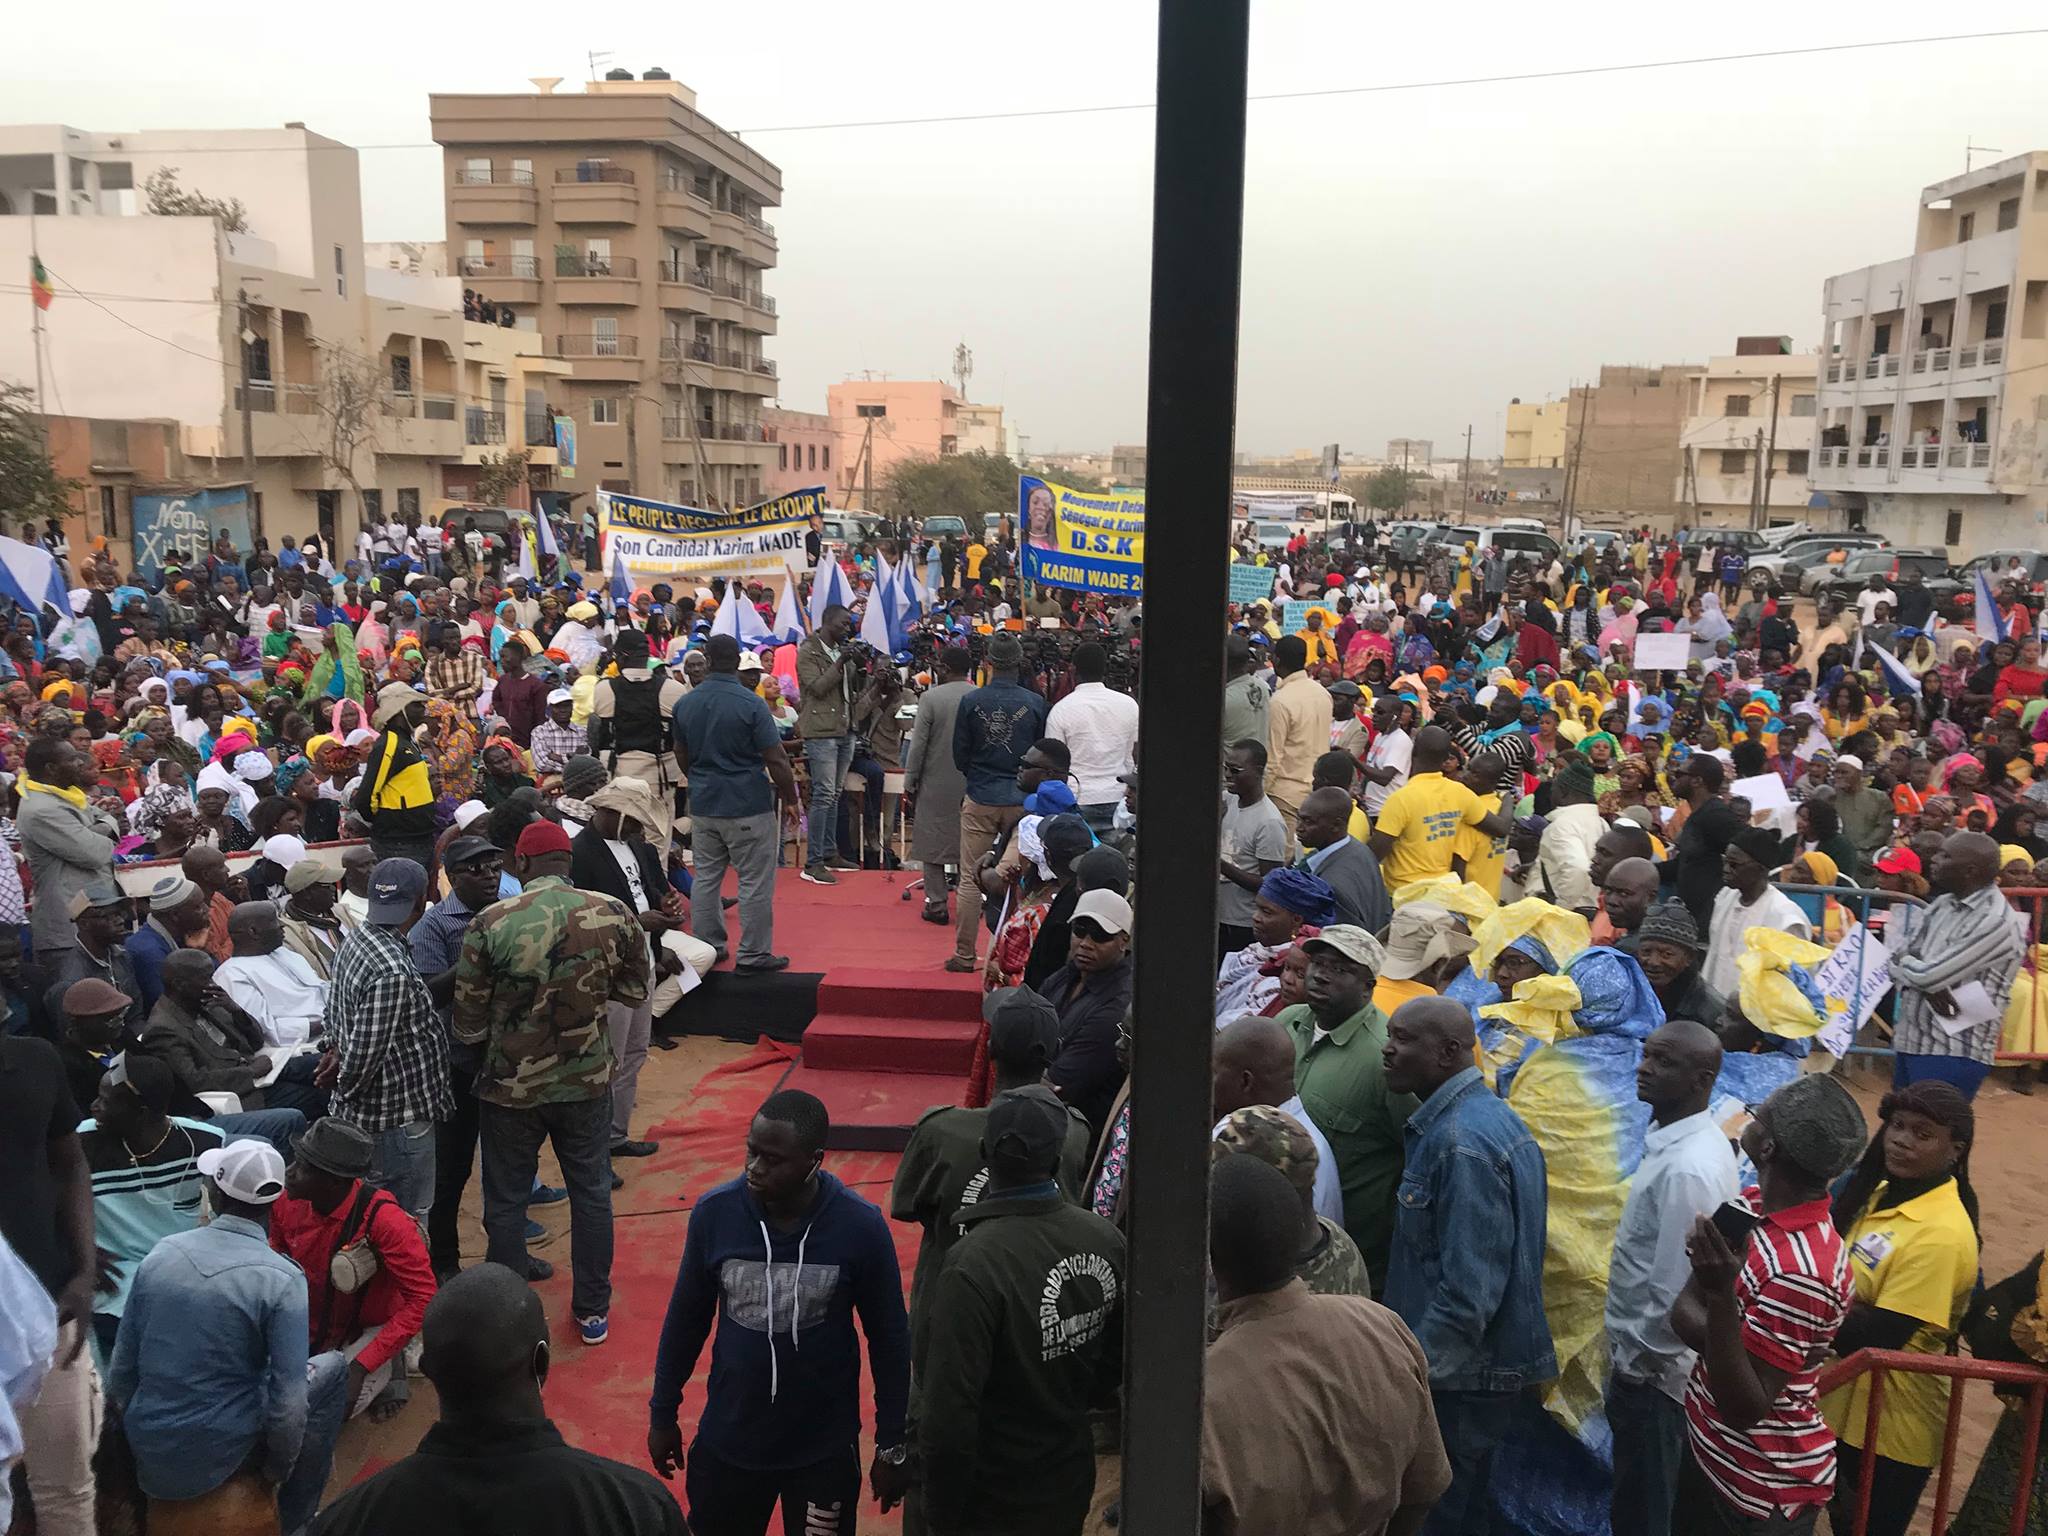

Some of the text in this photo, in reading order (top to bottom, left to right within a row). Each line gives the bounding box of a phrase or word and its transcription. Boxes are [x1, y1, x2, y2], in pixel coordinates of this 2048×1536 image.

[628, 504, 677, 529] PEUPLE
[761, 495, 816, 521] RETOUR
[614, 529, 803, 558] Son Candidat Karim WADE
[1071, 529, 1134, 557] D.S.K
[1041, 562, 1085, 585] KARIM
[1087, 569, 1129, 590] WADE
